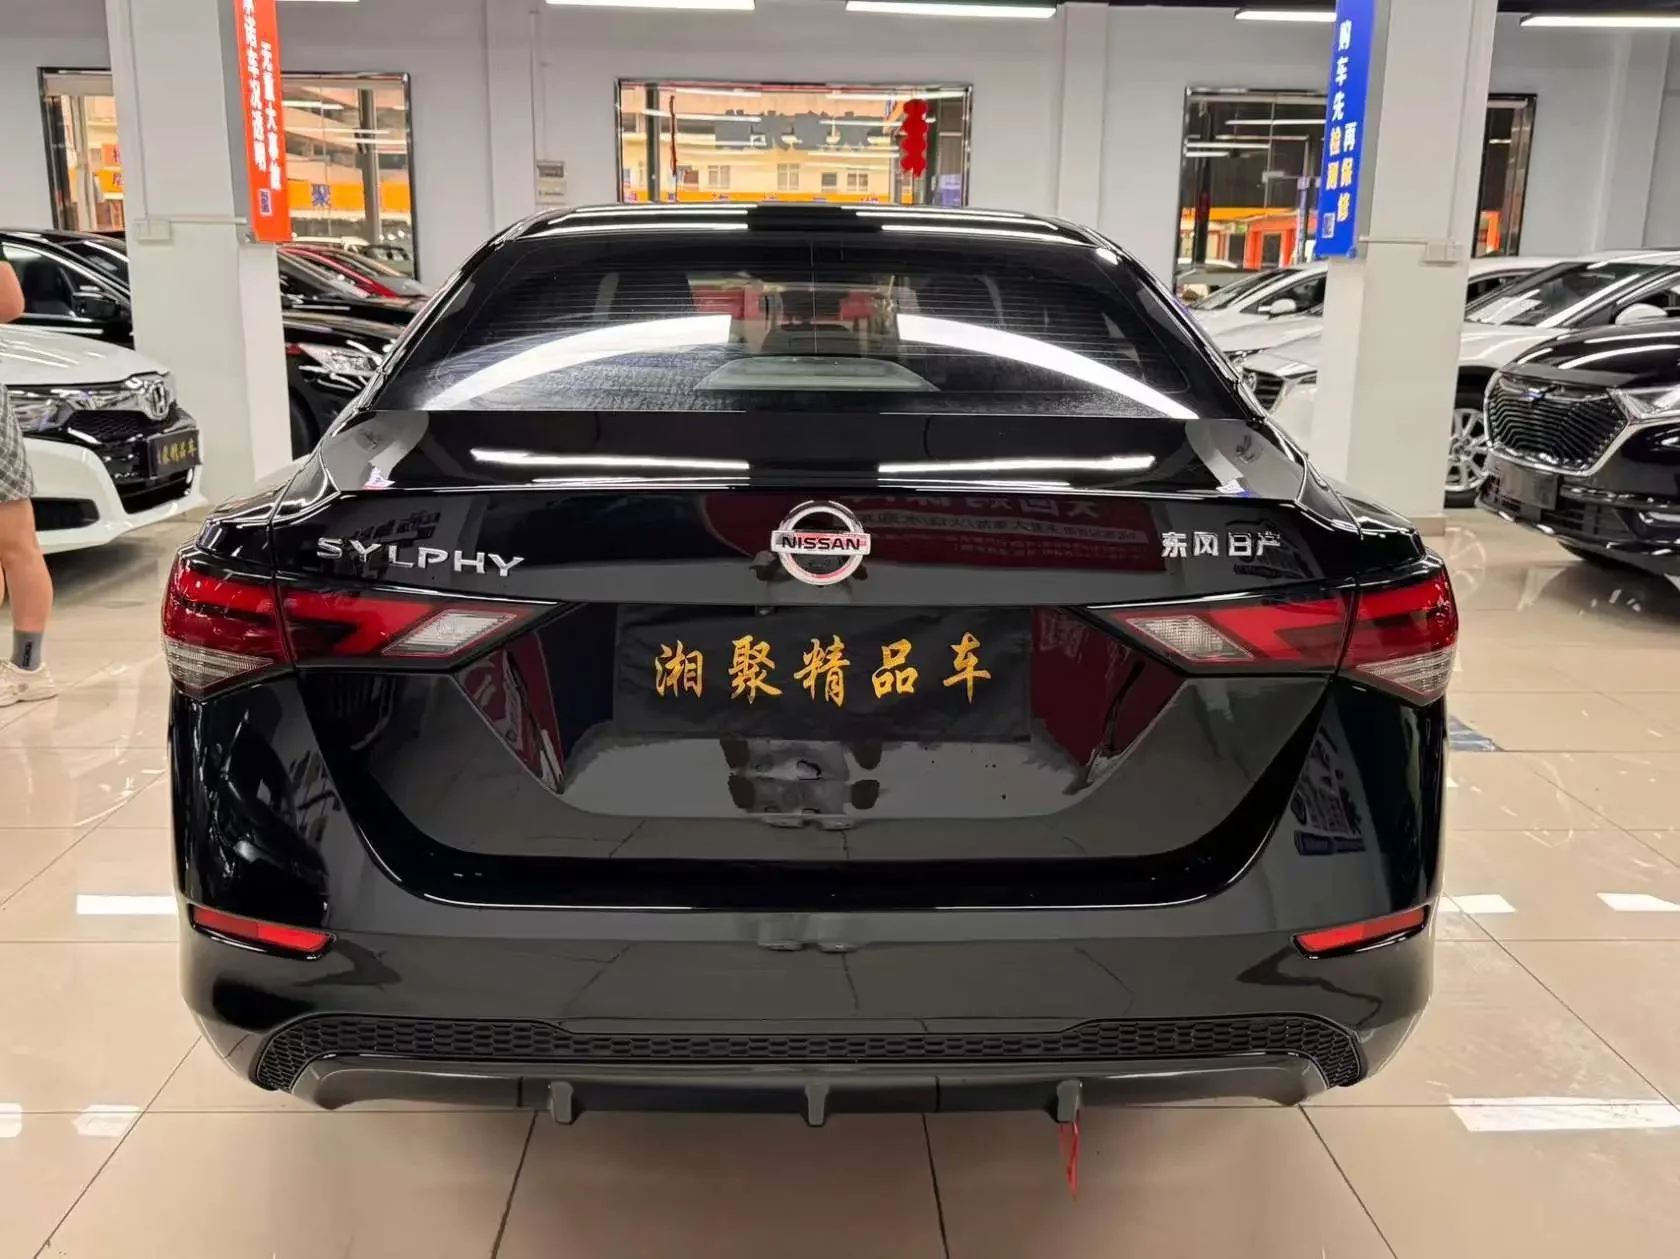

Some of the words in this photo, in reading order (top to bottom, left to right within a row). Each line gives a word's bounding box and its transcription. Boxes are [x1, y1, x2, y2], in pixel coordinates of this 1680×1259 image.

[1326, 19, 1353, 190] 购车先检测
[1337, 122, 1358, 222] 再保修
[316, 537, 525, 577] SYLPHY
[781, 536, 861, 550] NISSAN
[1161, 531, 1281, 558] 东风日产
[654, 631, 992, 708] 湘聚精品车
